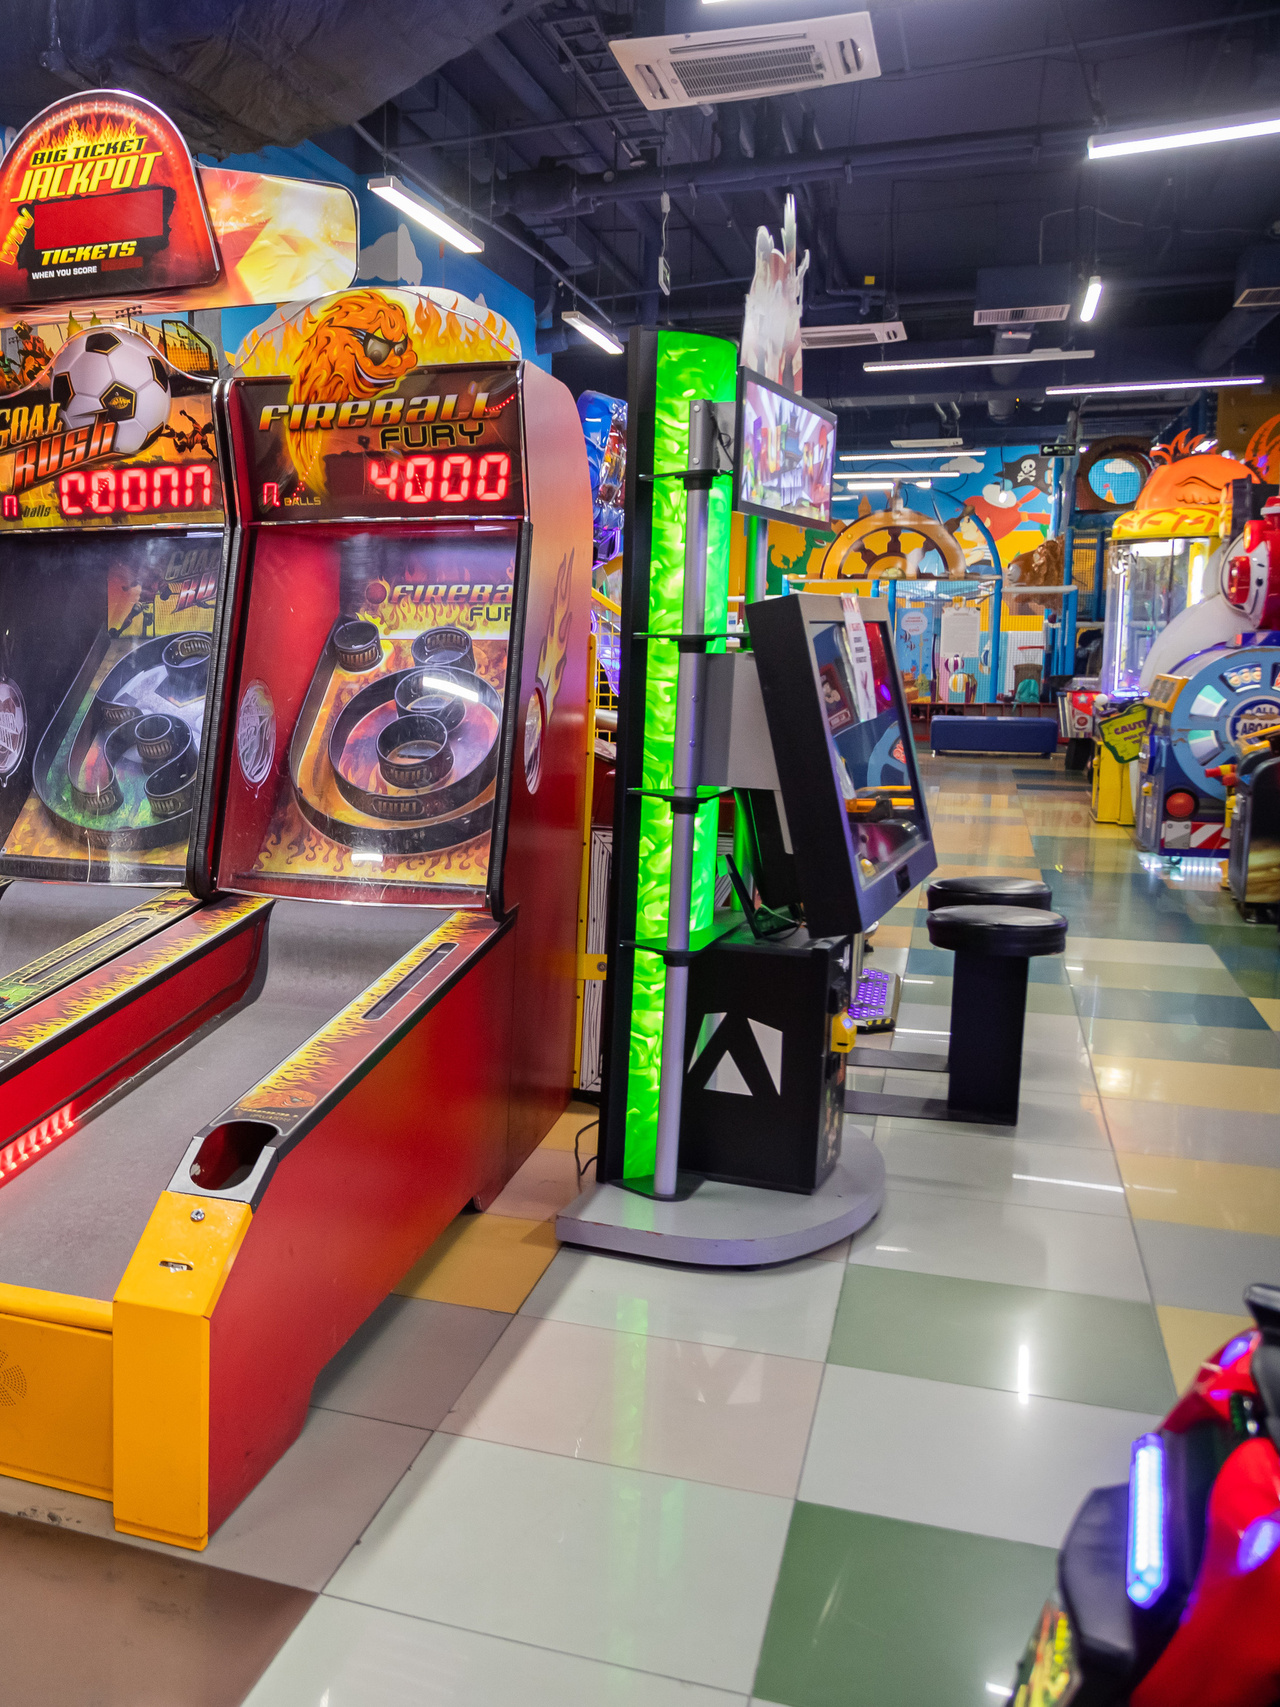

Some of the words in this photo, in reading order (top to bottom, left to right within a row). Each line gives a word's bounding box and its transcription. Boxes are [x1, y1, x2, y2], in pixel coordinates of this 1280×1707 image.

[31, 148, 68, 166] BIG
[73, 136, 148, 160] TICKET
[10, 151, 164, 203] JACKPOT
[41, 240, 138, 266] TICKETS
[31, 269, 55, 280] WHEN
[56, 267, 72, 277] YOU
[73, 265, 98, 275] SCORE
[258, 392, 501, 431] FIREBALL
[380, 422, 484, 450] FURY
[369, 452, 511, 503] 4000
[23, 504, 51, 518] balls
[284, 496, 322, 507] BALLS
[390, 584, 513, 603] FIREBA
[1256, 706, 1275, 714] ALL
